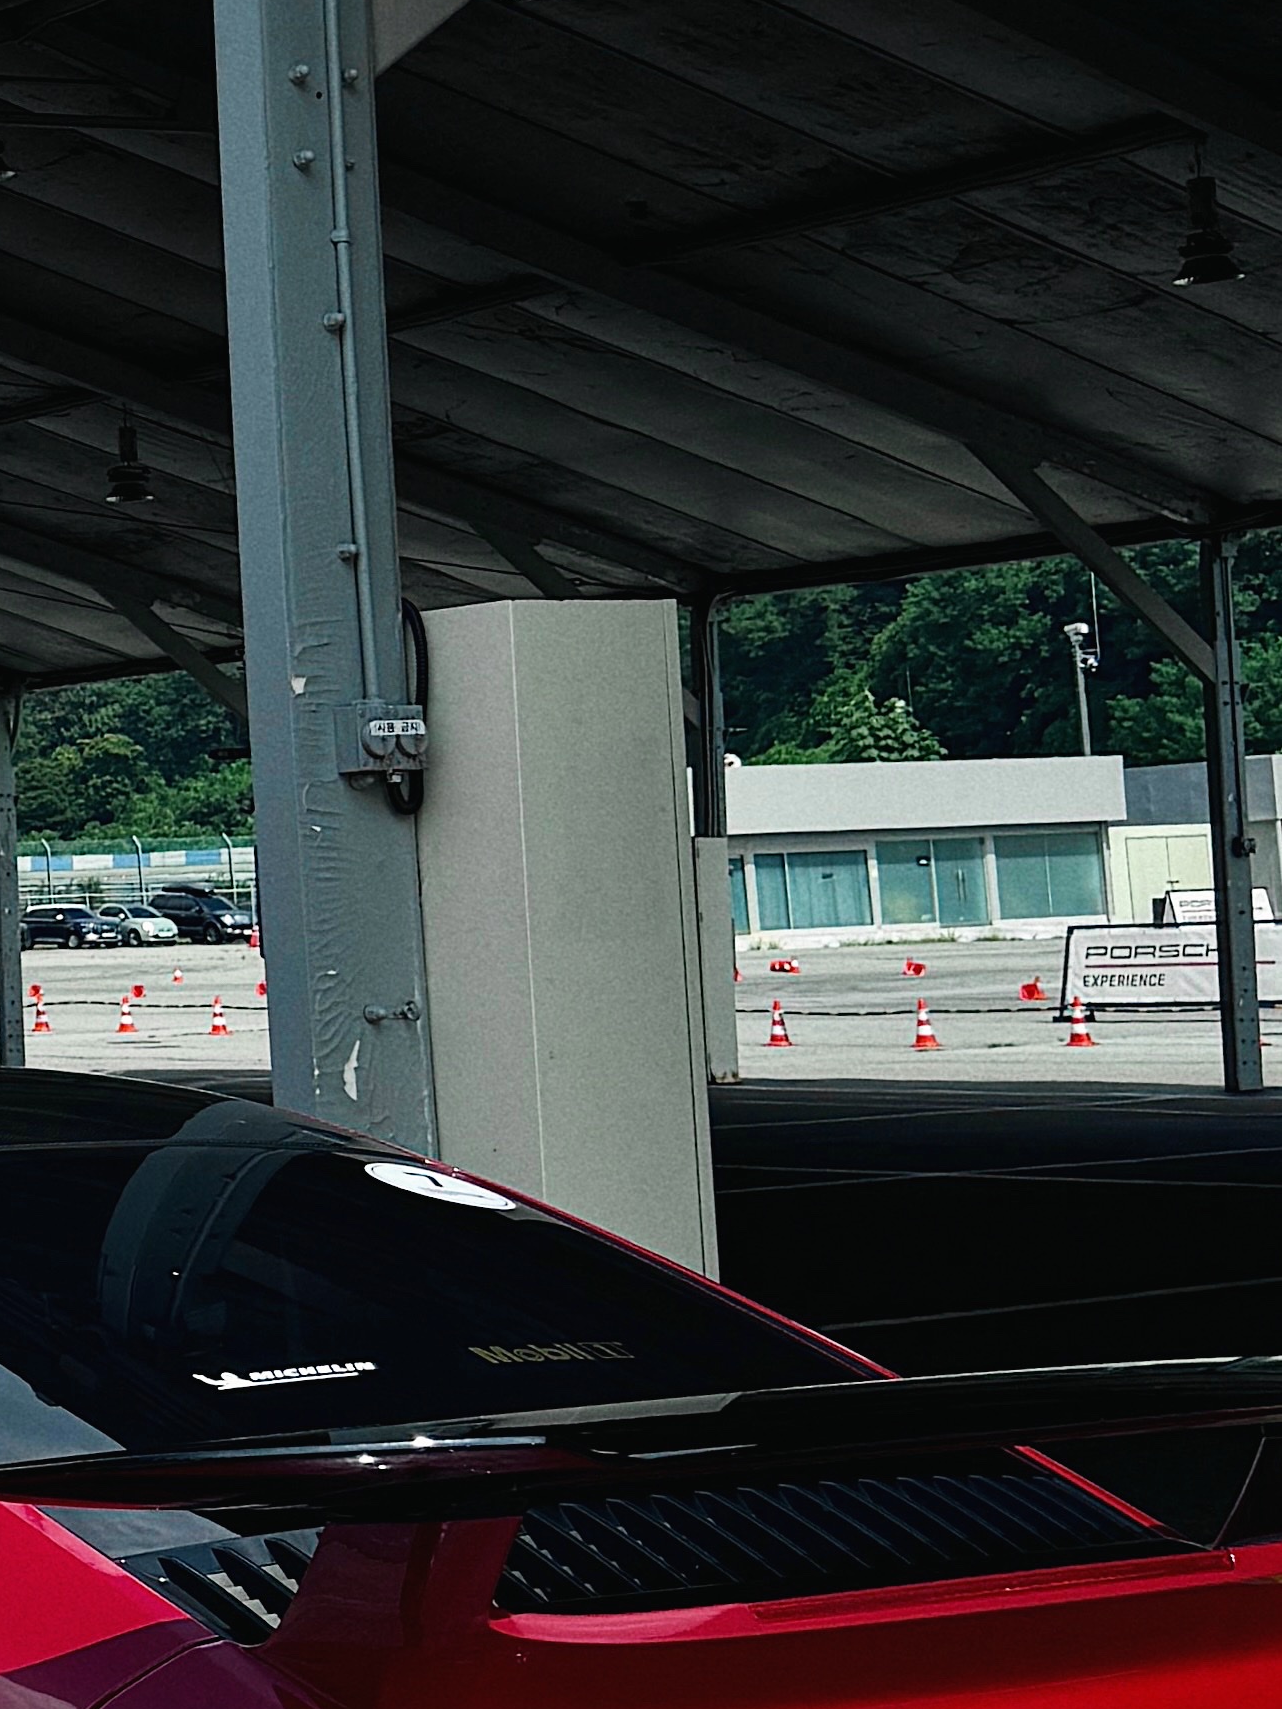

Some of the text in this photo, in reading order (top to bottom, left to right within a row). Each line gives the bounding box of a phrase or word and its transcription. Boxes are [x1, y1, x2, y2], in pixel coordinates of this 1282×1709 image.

[1085, 944, 1218, 959] PORSCH
[1083, 973, 1165, 987] EXPERIENCE
[468, 1343, 595, 1363] Mobil
[249, 1361, 377, 1380] MICHELIN
